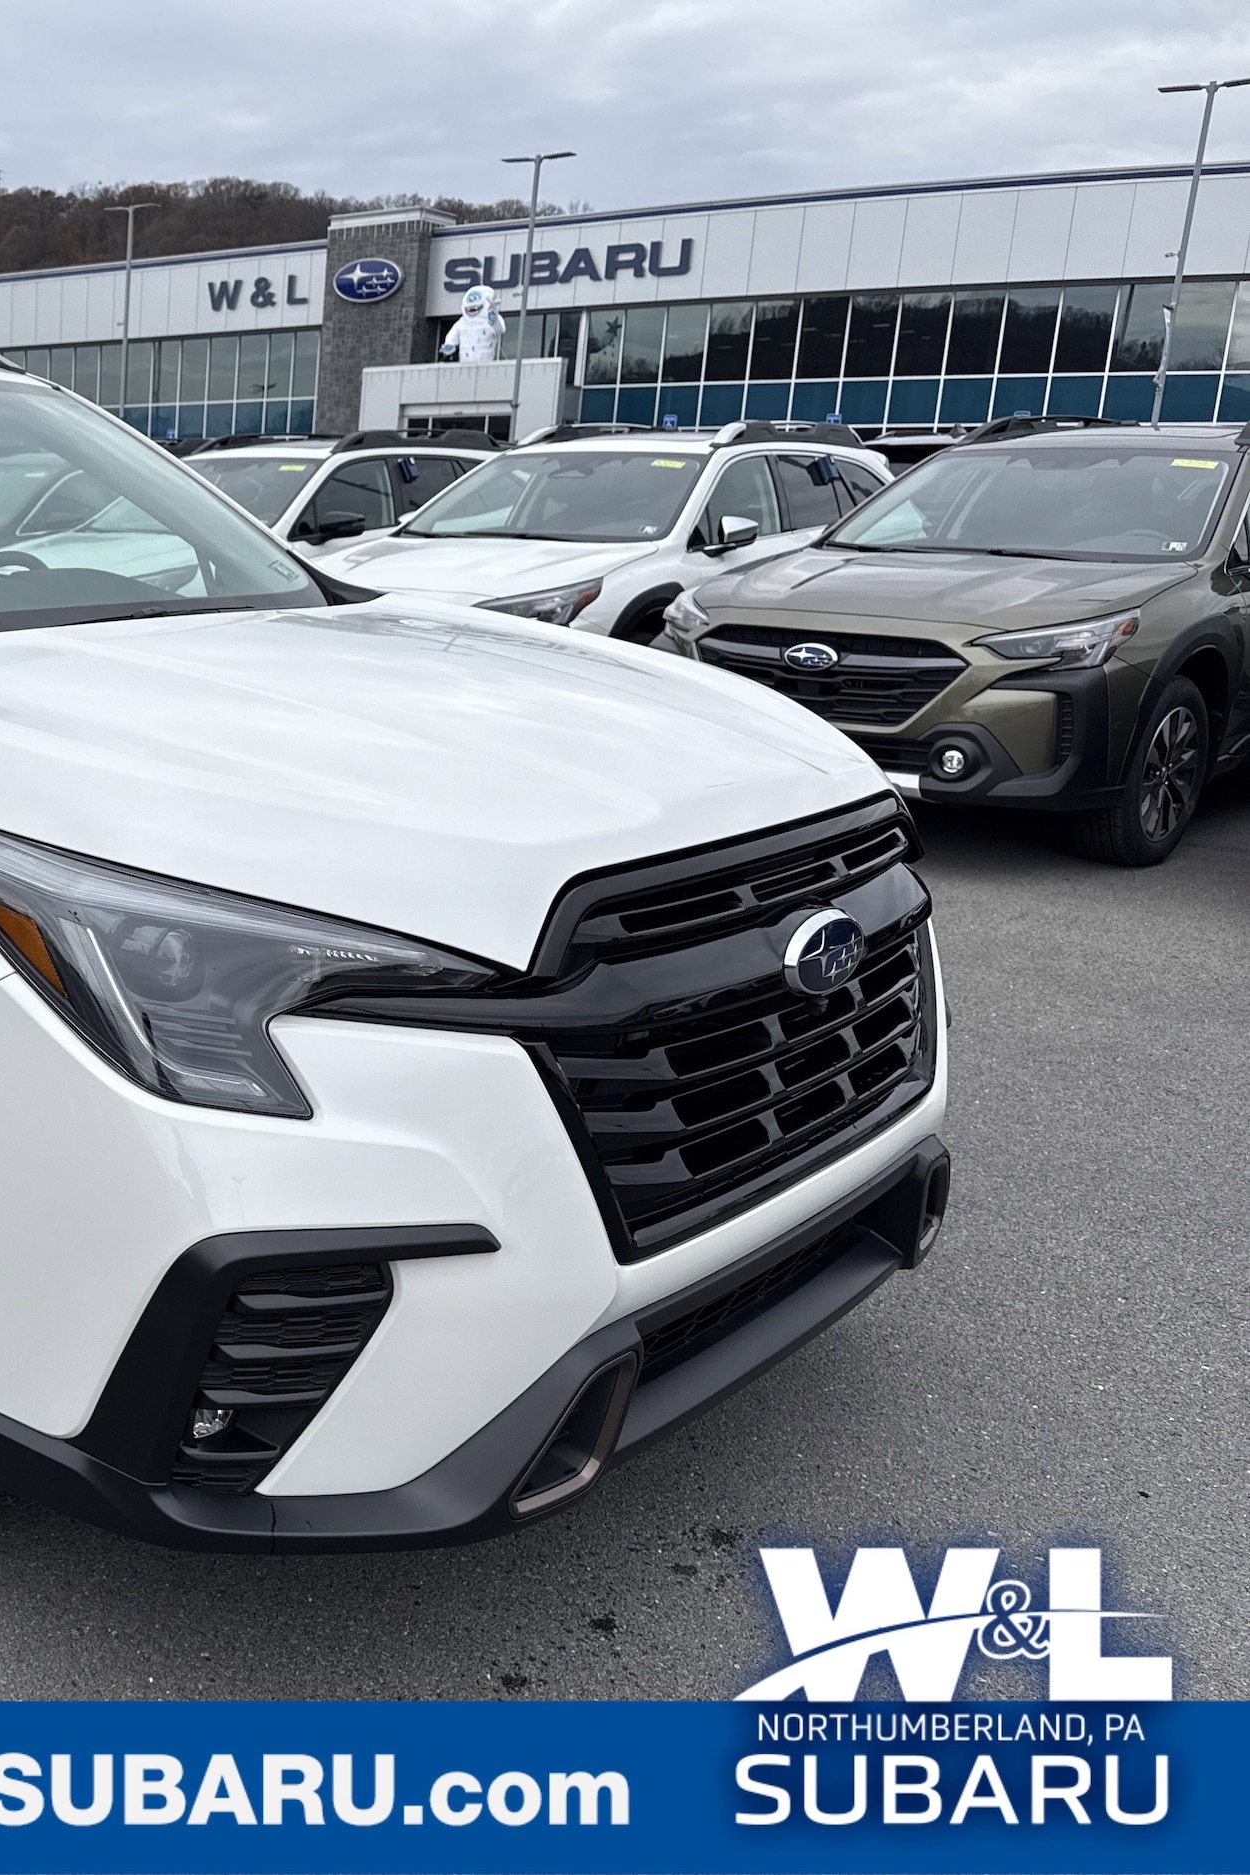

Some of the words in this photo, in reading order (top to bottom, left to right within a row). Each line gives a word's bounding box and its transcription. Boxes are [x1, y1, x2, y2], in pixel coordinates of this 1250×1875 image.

[443, 238, 693, 293] SUBARU
[207, 279, 243, 312] W
[250, 276, 276, 308] &
[286, 274, 309, 305] L
